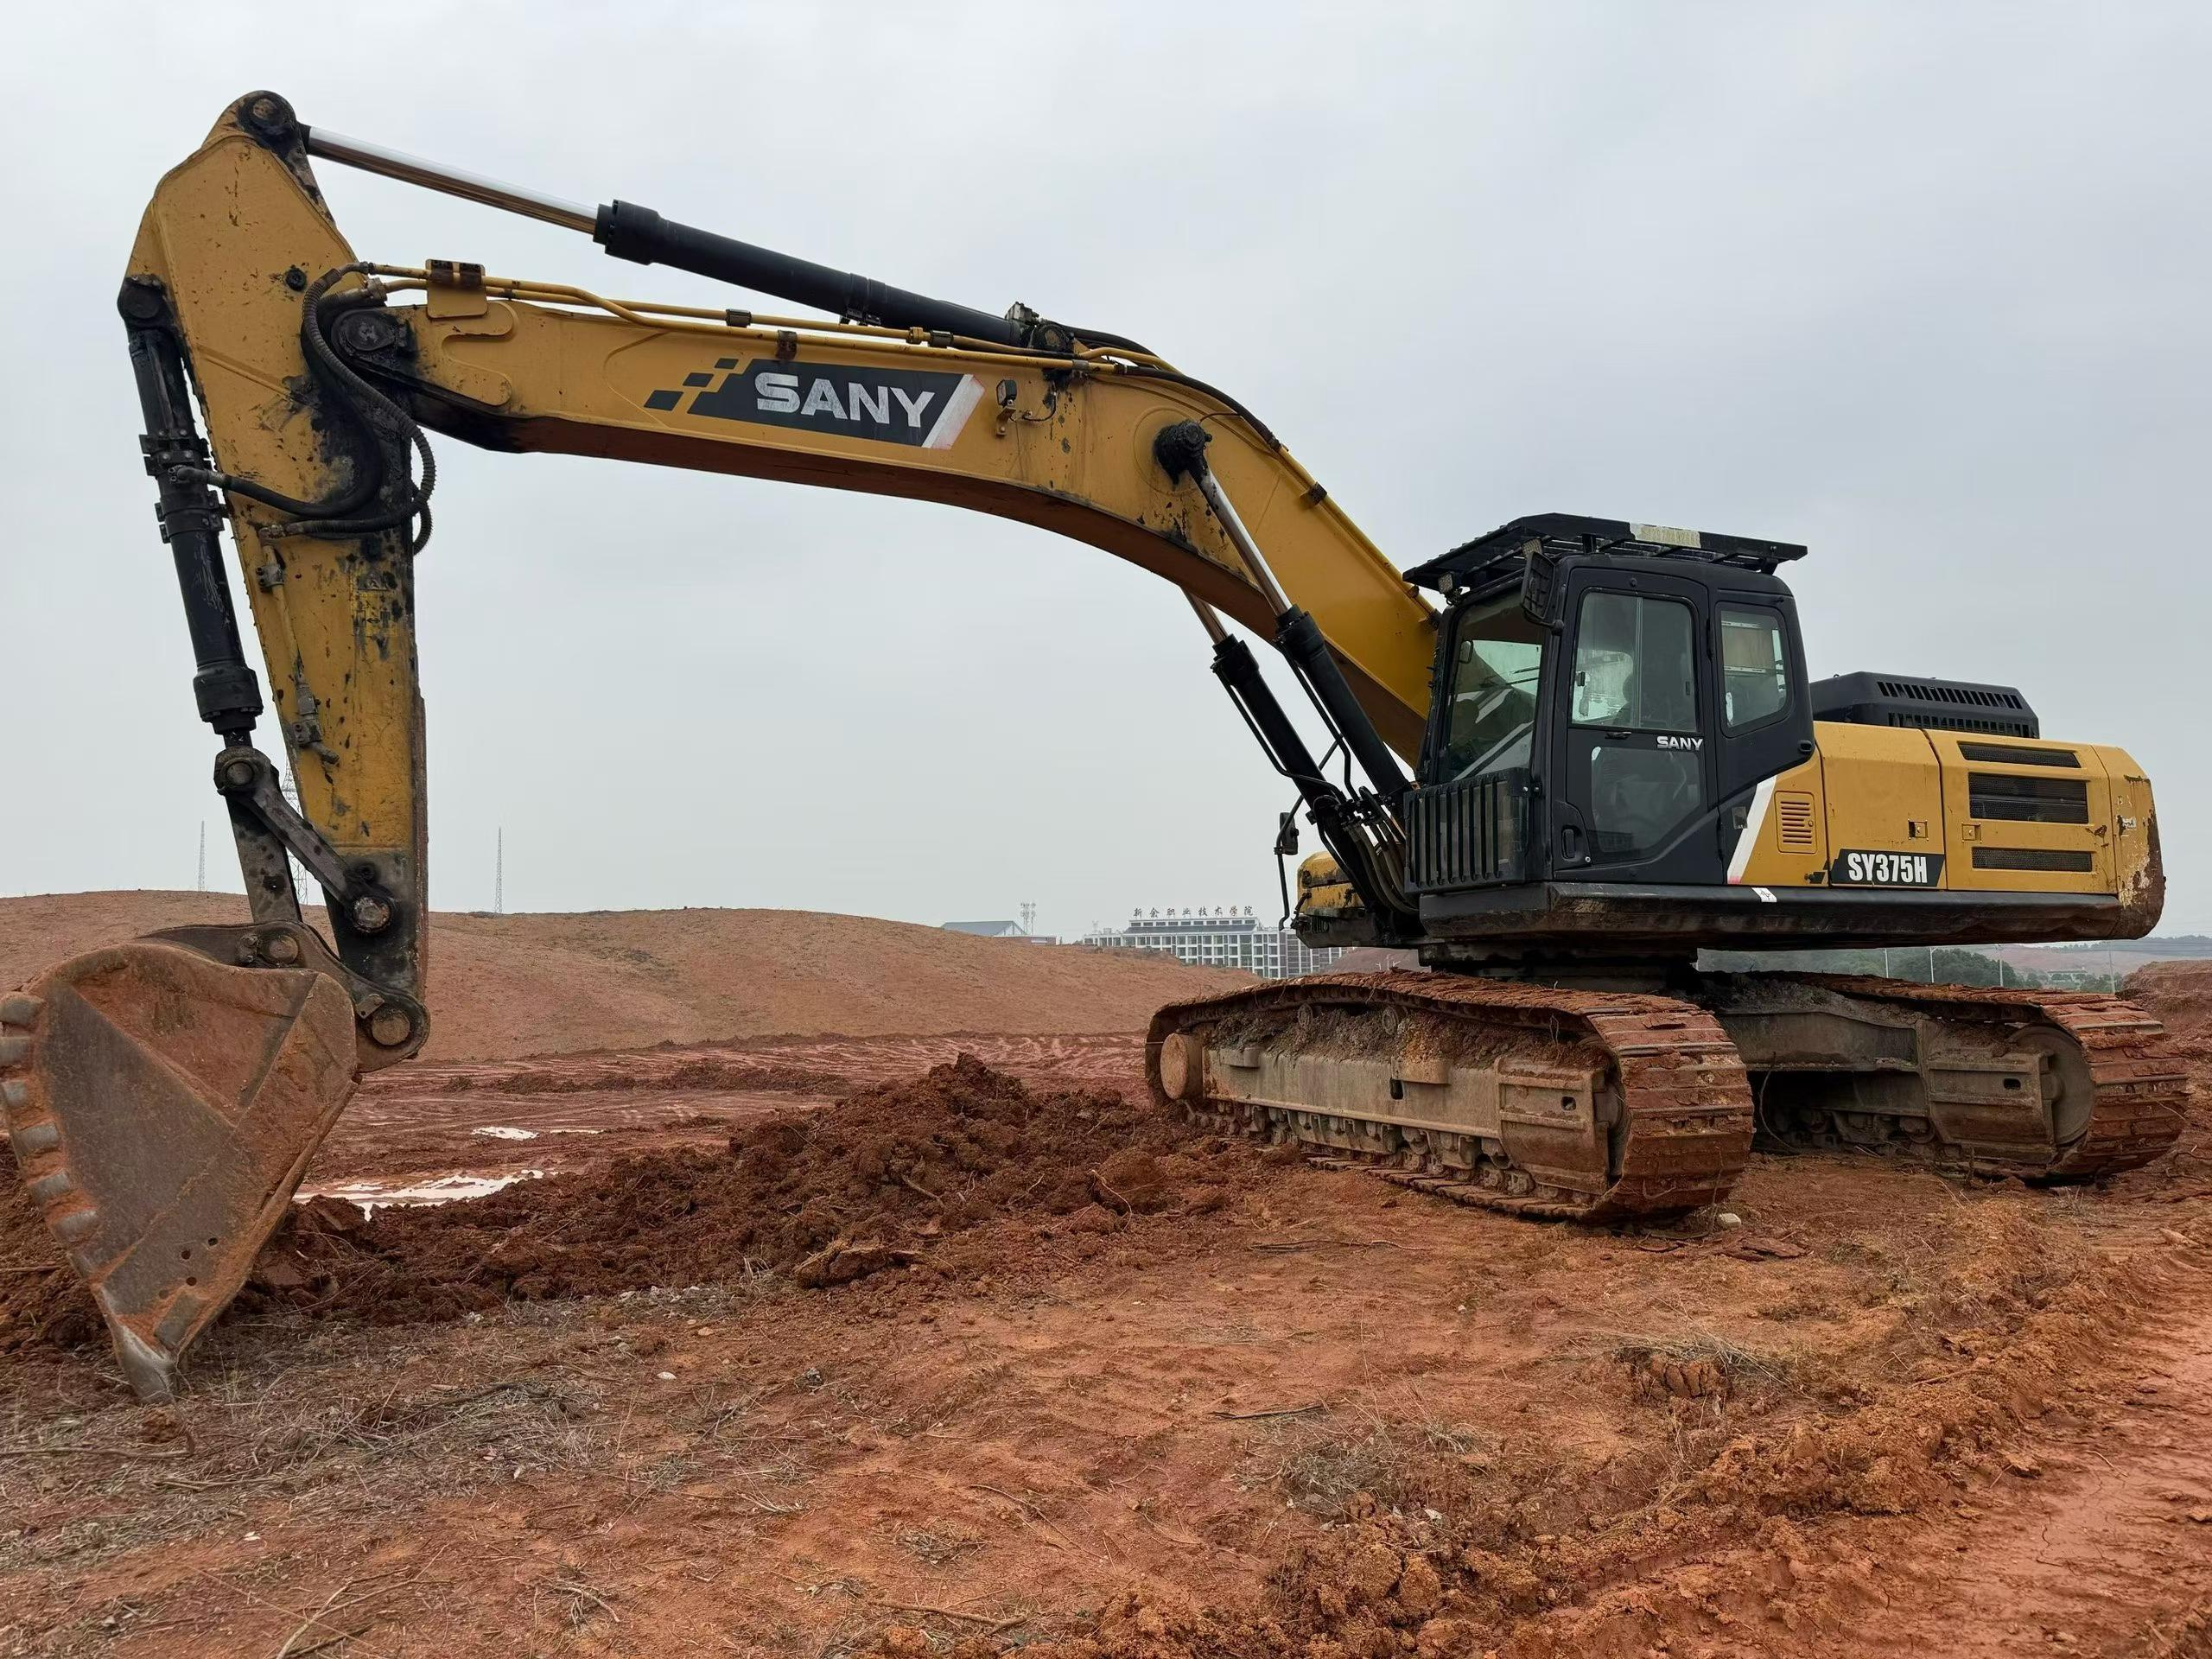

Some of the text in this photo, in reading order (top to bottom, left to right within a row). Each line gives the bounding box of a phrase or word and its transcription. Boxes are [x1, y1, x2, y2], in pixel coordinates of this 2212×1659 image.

[754, 372, 935, 428] SANY
[1657, 736, 1703, 750] SANY
[1847, 853, 1928, 883] SY375H
[1133, 906, 1254, 918] 新余职业技术学院
